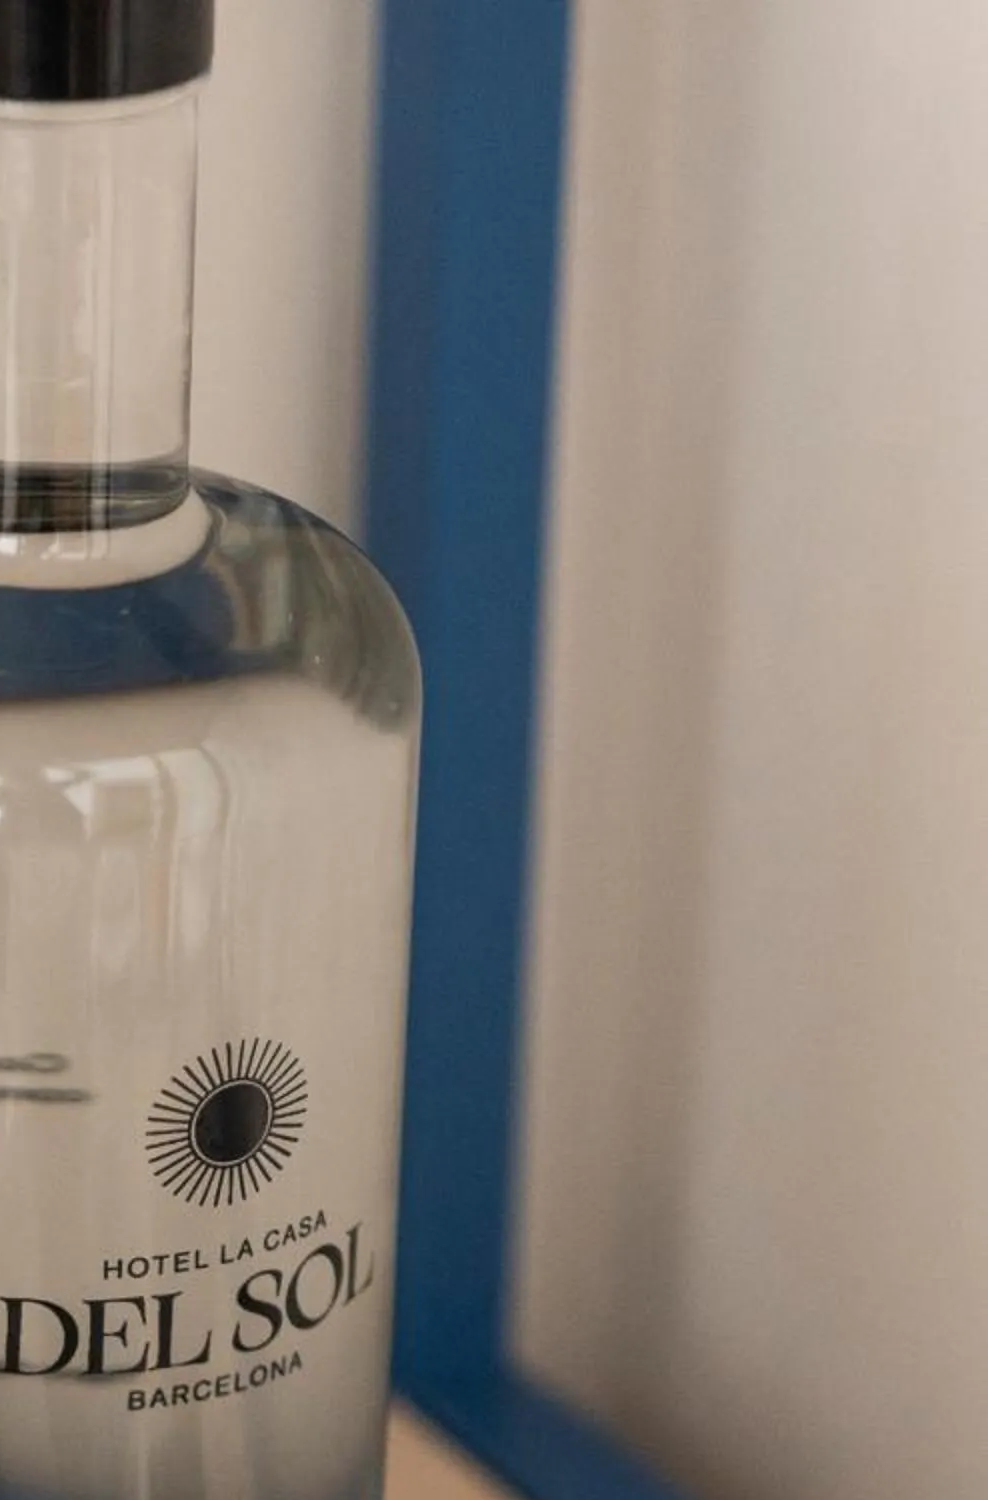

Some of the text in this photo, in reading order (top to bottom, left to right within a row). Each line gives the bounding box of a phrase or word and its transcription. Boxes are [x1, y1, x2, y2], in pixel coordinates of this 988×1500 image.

[102, 1209, 328, 1280] HOTEL LA CASA
[231, 1221, 376, 1354] SOL
[127, 1351, 303, 1411] BARCELONA
